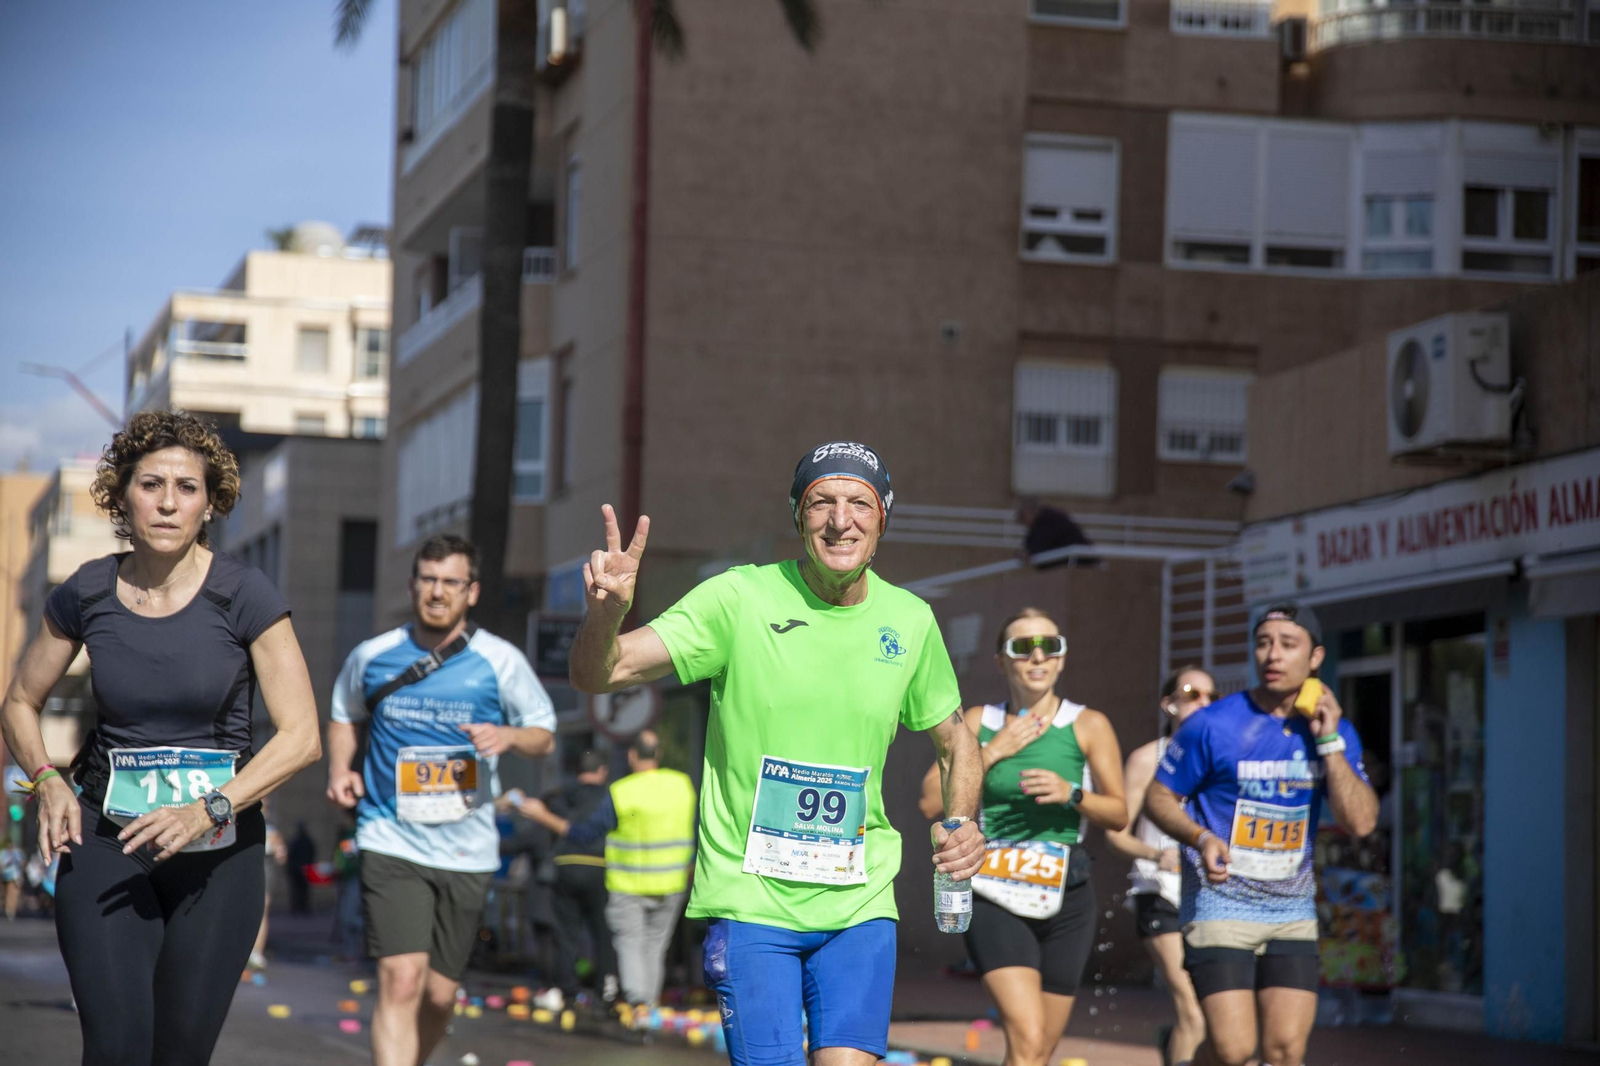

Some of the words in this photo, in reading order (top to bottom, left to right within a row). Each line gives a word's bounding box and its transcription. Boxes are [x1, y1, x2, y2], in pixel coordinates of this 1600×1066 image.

[1318, 523, 1371, 568] BAZAR
[1377, 519, 1390, 557] Y
[1396, 478, 1538, 555] ALIMENTACIÓN
[791, 773, 816, 783] Almería
[816, 777, 833, 785] 2025
[792, 767, 810, 776] Medio
[811, 770, 834, 778] Maratón
[140, 769, 214, 804] 118
[796, 787, 847, 825] 99
[794, 822, 815, 830] SALVA
[817, 825, 844, 834] MOLINA
[1245, 819, 1302, 842] 1115
[986, 848, 1059, 879] 1125
